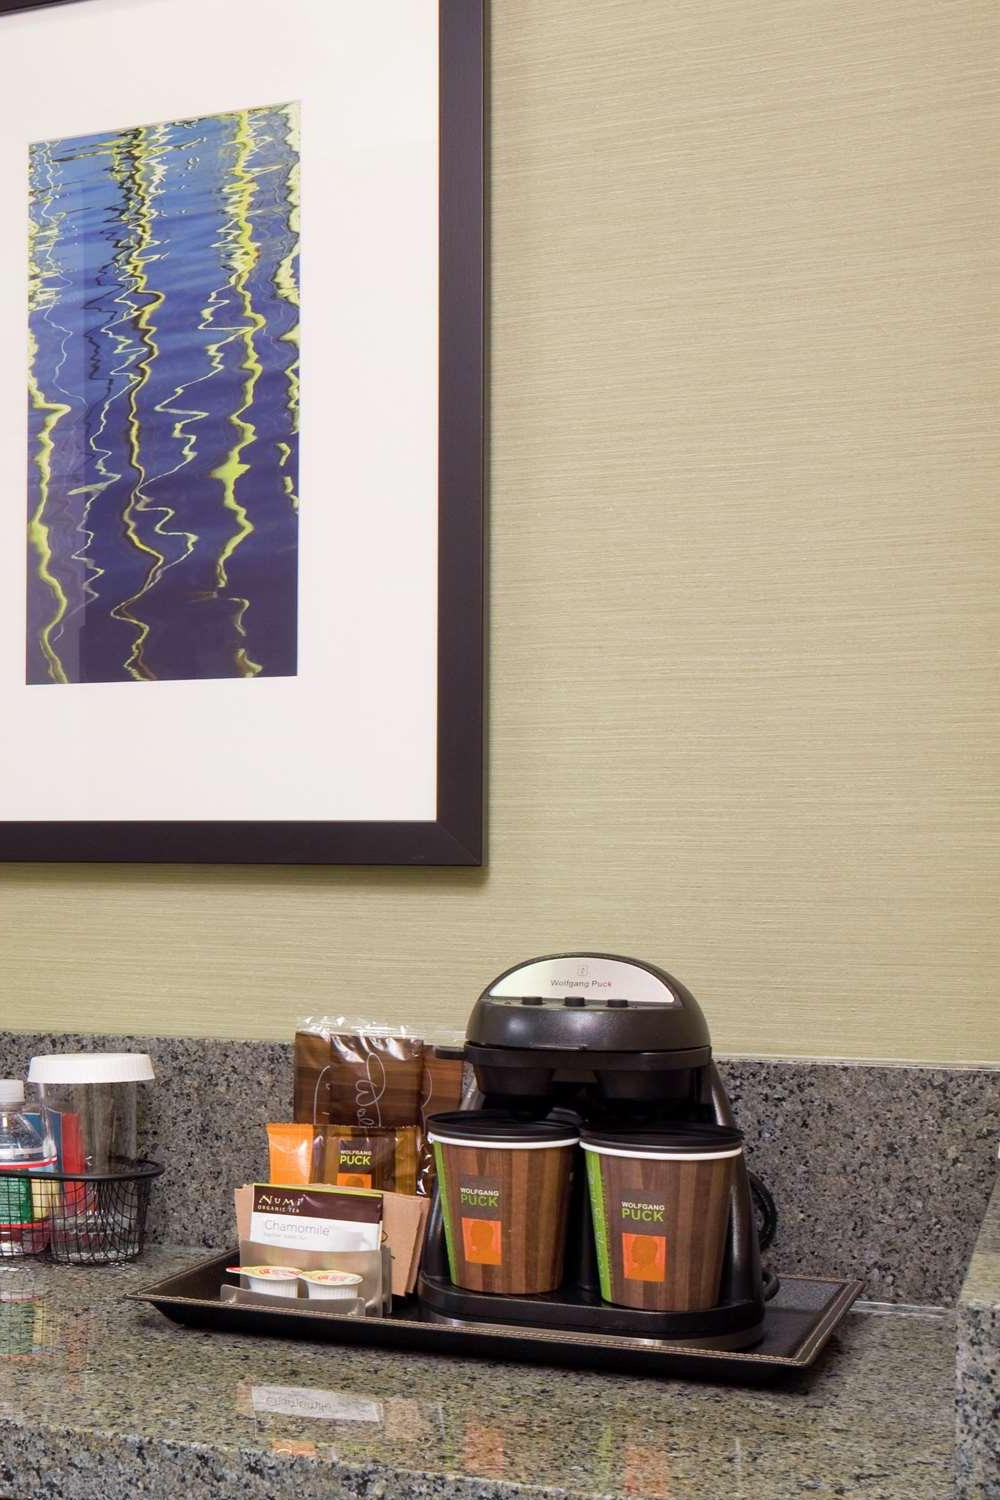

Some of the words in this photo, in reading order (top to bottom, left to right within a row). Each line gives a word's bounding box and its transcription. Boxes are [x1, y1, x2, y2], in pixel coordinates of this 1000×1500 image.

[550, 979, 590, 989] Wolfgang
[591, 979, 612, 988] Puck
[339, 1155, 371, 1166] PUCK
[460, 1187, 499, 1197] WOLFGANG
[460, 1195, 498, 1207] PUCK
[621, 1201, 665, 1211] WOLFGANG
[257, 1205, 286, 1213] ORGANIC
[621, 1208, 664, 1222] PUCK
[264, 1219, 330, 1236] Chamomile
